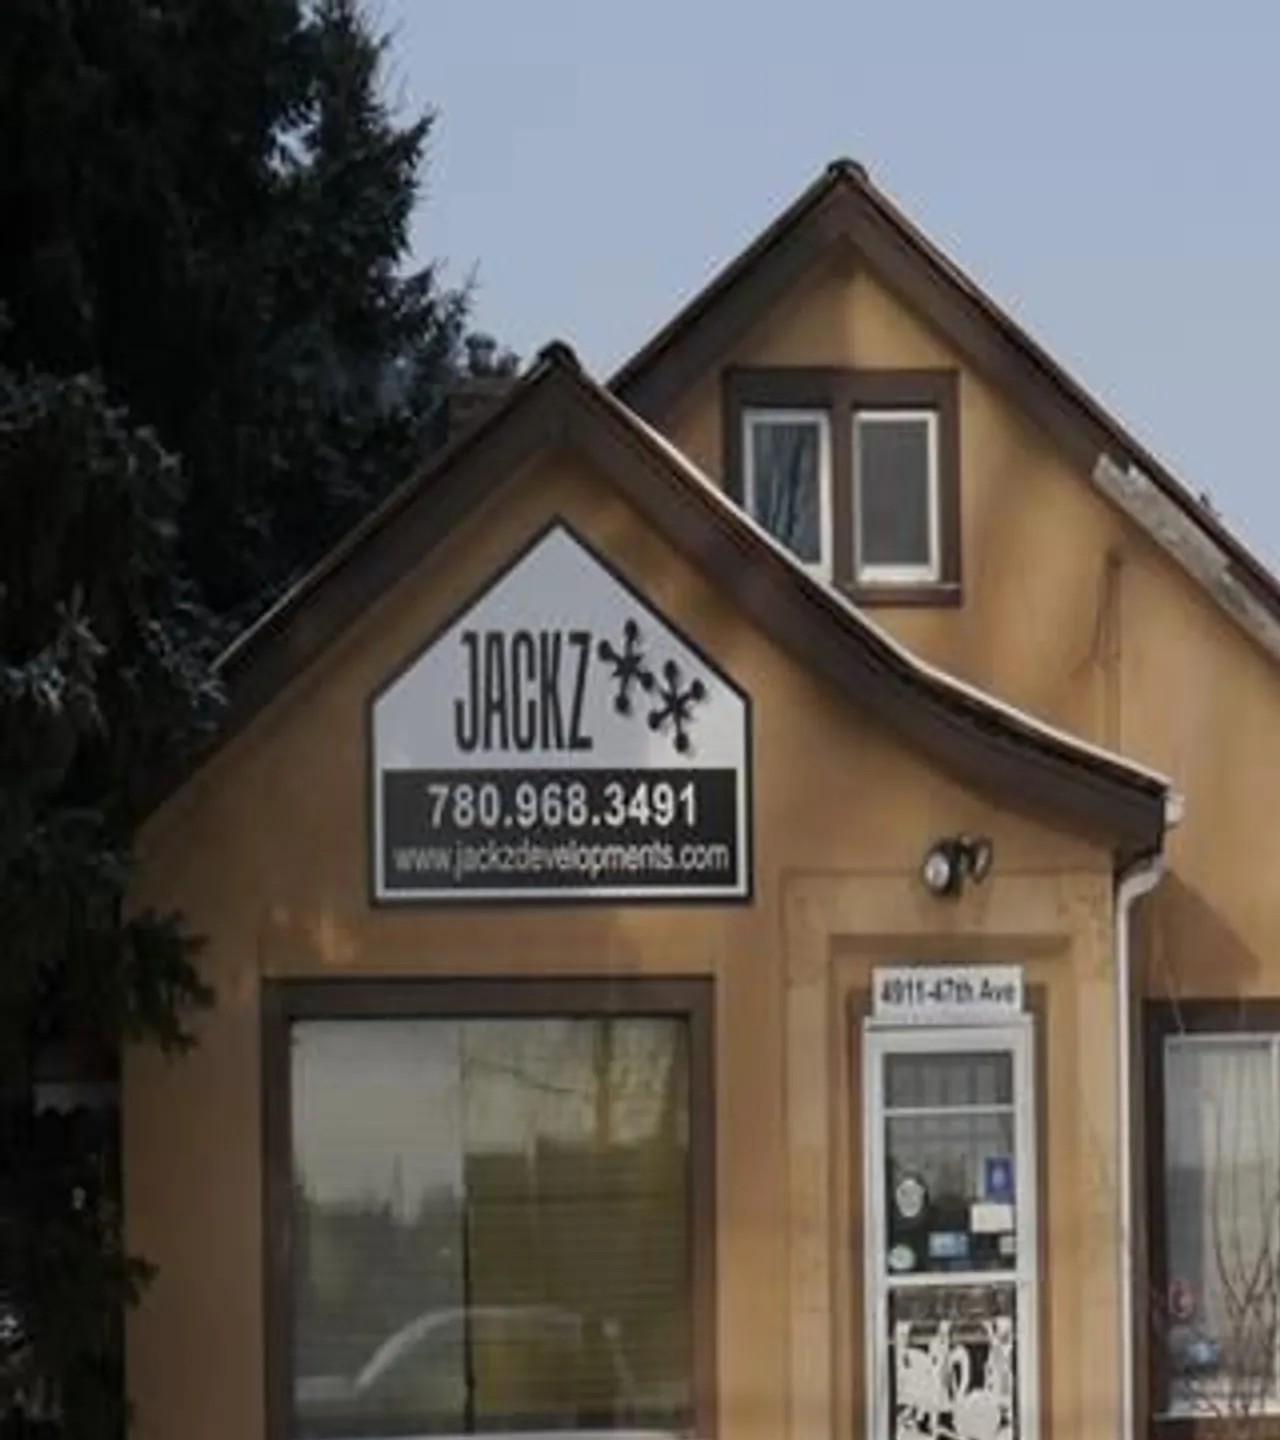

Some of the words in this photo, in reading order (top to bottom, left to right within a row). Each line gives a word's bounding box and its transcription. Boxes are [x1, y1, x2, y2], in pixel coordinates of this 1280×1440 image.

[454, 629, 594, 753] JACKZ
[428, 781, 698, 828] 780.968.3491
[393, 840, 730, 881] www.jackzdevelopments.com
[881, 976, 974, 1005] 4911-47th
[981, 976, 1016, 1005] Ave
